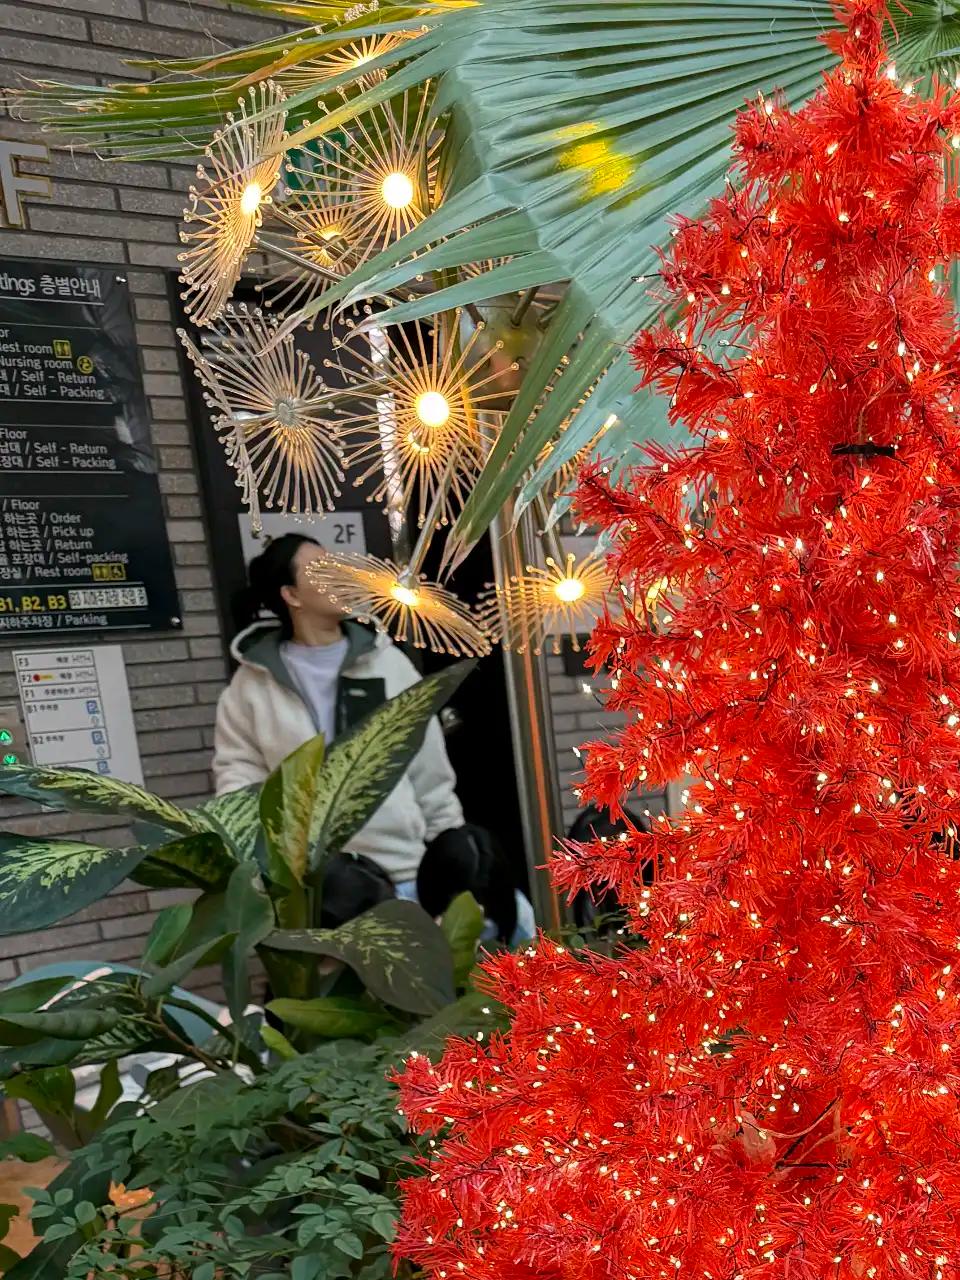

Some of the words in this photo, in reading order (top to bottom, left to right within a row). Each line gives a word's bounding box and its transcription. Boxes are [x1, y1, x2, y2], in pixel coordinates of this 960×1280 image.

[40, 275, 101, 298] 층별안내
[24, 344, 53, 354] room
[44, 358, 73, 369] room
[21, 370, 44, 382] Self
[57, 371, 97, 384] Return
[24, 384, 47, 396] Self
[60, 385, 105, 400] Packing
[0, 427, 28, 440] Floor
[33, 441, 57, 454] Self
[69, 443, 108, 454] Return
[0, 455, 24, 468] 장대
[35, 455, 60, 468] Self
[72, 456, 117, 470] Packing
[10, 499, 40, 510] Floor
[3, 512, 37, 525] 하는곳
[49, 512, 81, 524] Order
[6, 525, 40, 539] 하는곳
[52, 526, 77, 537] Pick
[79, 528, 95, 539] up
[333, 524, 356, 544] 2F
[8, 539, 43, 552] 하는곳
[54, 539, 93, 551] Return
[11, 552, 46, 566] 포장대
[34, 566, 61, 577] Rest
[63, 567, 92, 577] room
[47, 595, 67, 610] B3
[65, 614, 108, 627] Parking
